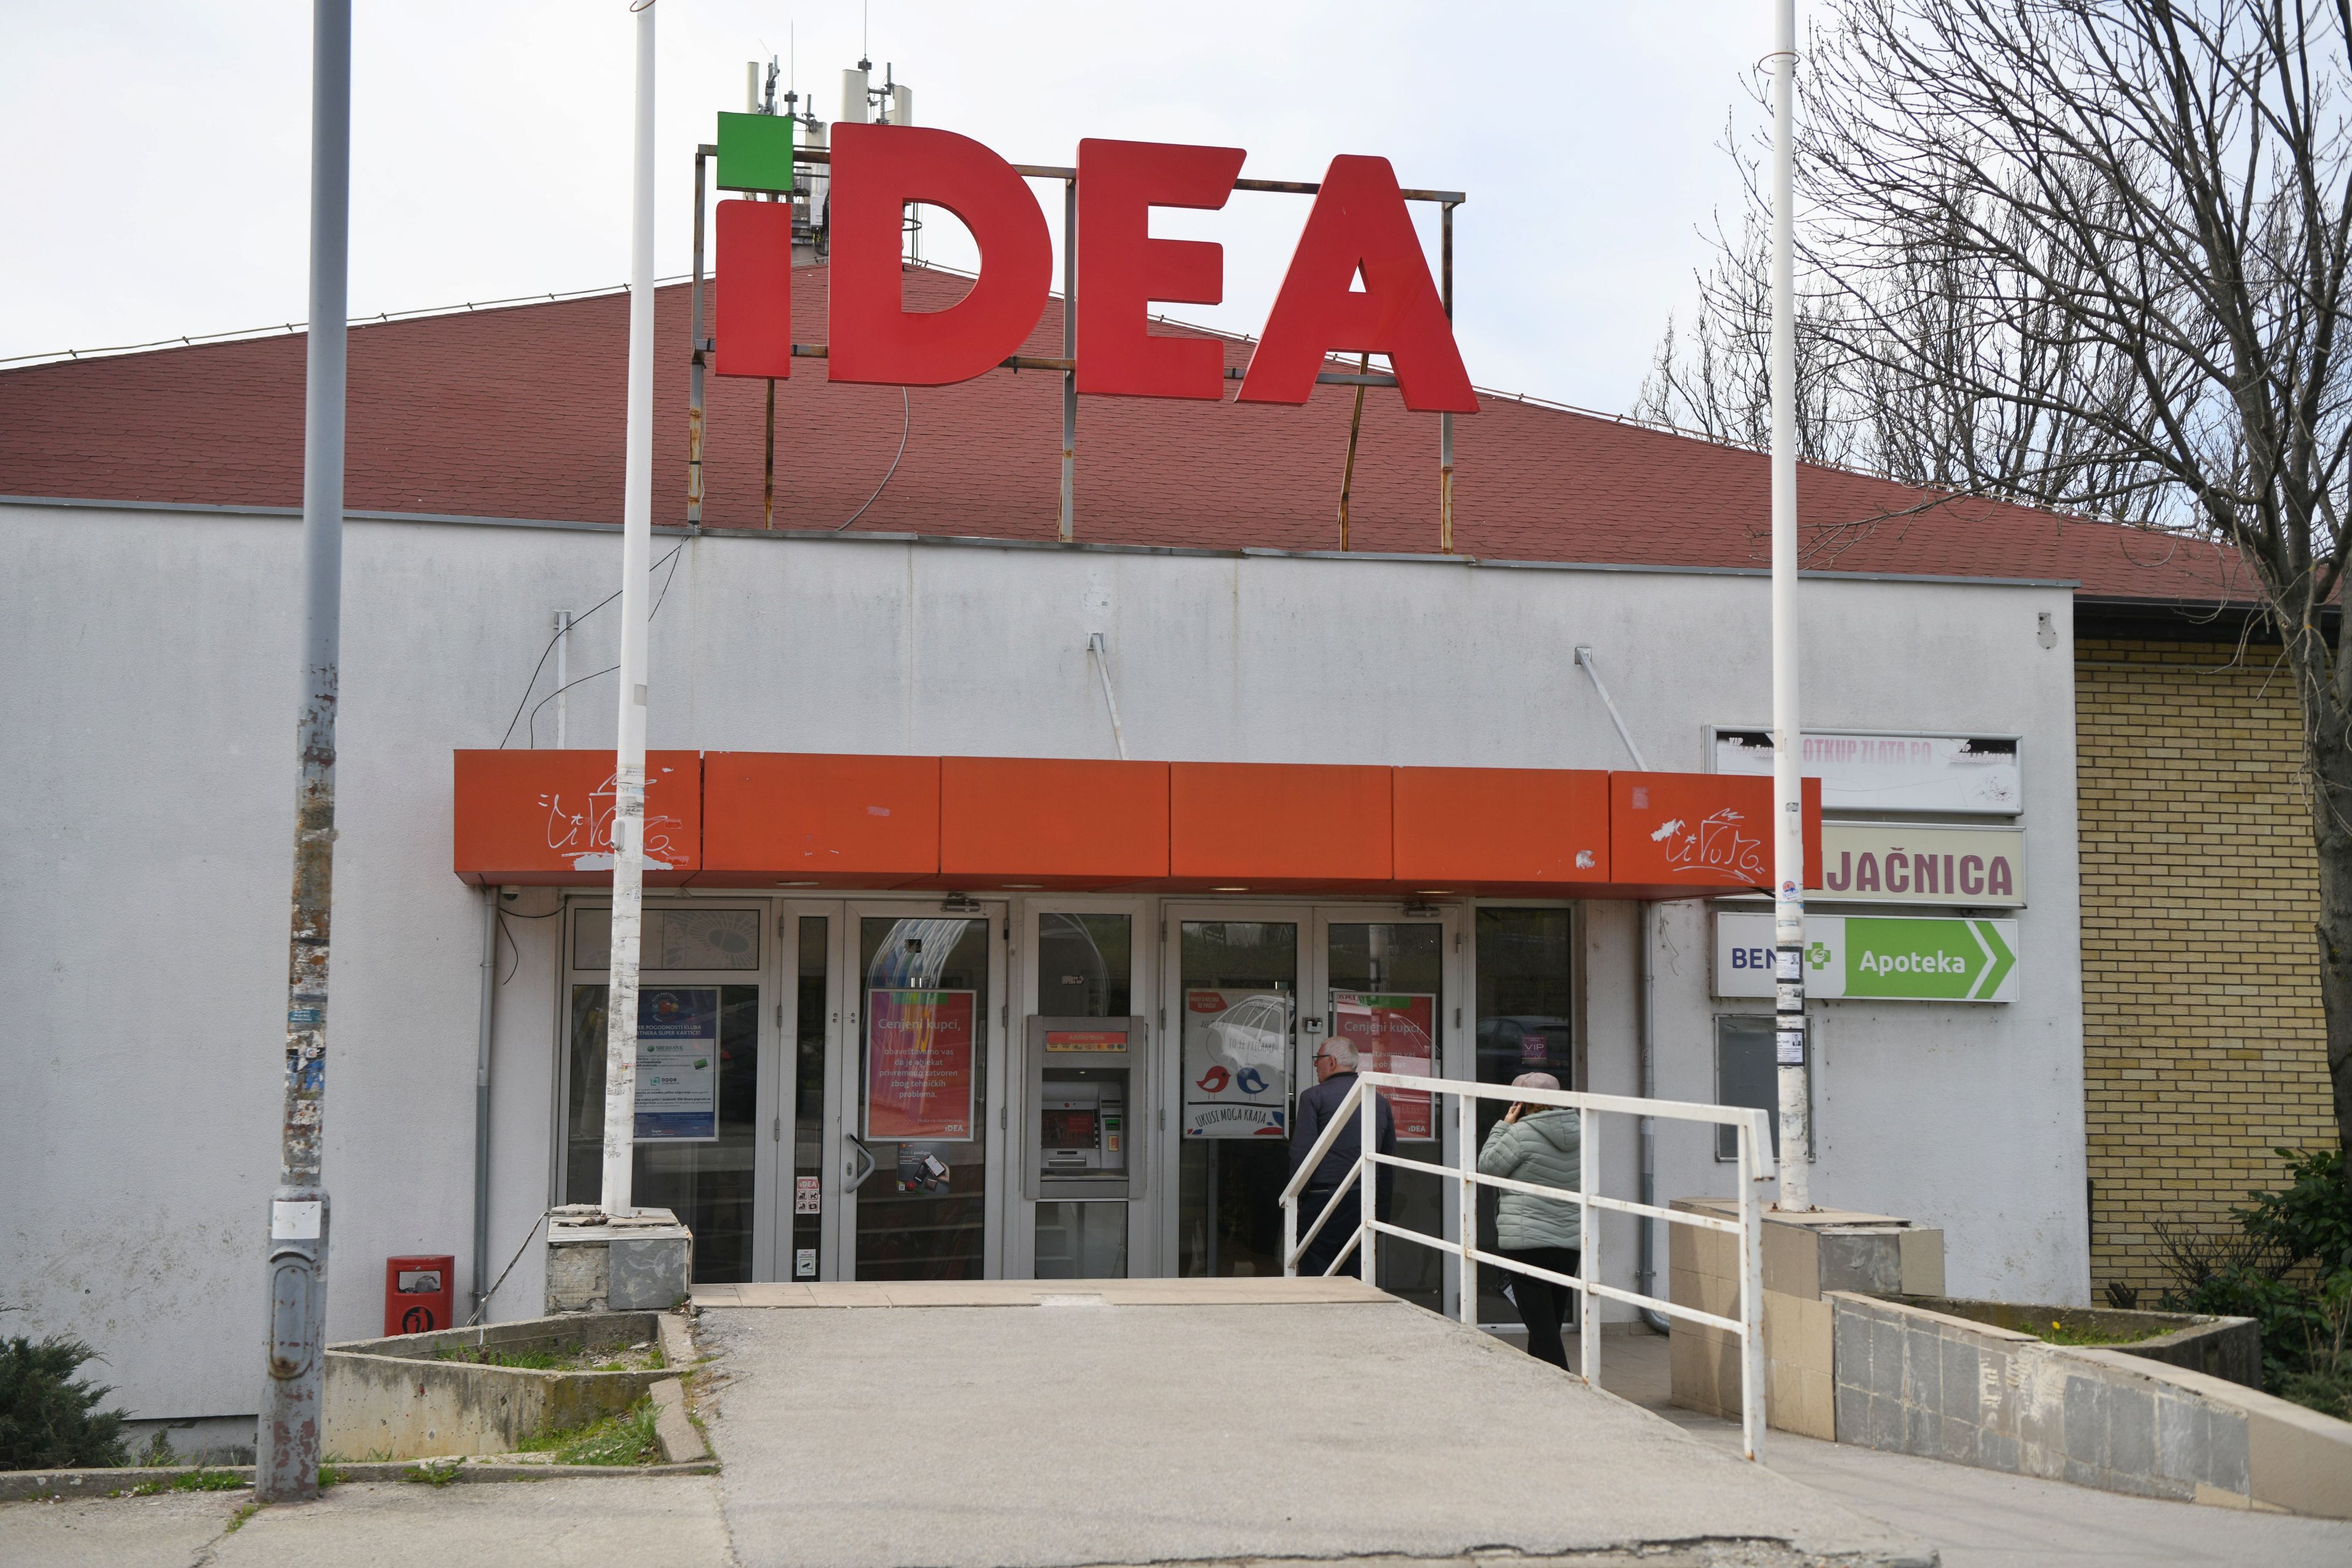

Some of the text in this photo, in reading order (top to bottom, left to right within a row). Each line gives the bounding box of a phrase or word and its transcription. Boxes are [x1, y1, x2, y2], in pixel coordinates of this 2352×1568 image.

[1729, 737, 1743, 745] VIP
[1803, 738, 1857, 763] OTKUP
[1861, 740, 1905, 764] ZLATA
[1822, 847, 2012, 895] JAČNICA
[1859, 950, 1965, 977] Apoteka
[878, 1018, 960, 1032] Cenjeni kupci,
[1344, 1021, 1422, 1035] Cenjeni kupci,
[915, 1059, 943, 1068] objekat
[1379, 1061, 1406, 1069] objekat
[879, 1069, 923, 1078] privremeno
[891, 1080, 909, 1088] zbog
[899, 1091, 937, 1099] problema.
[1195, 1108, 1266, 1127] UKUSI MOGA KRAJA
